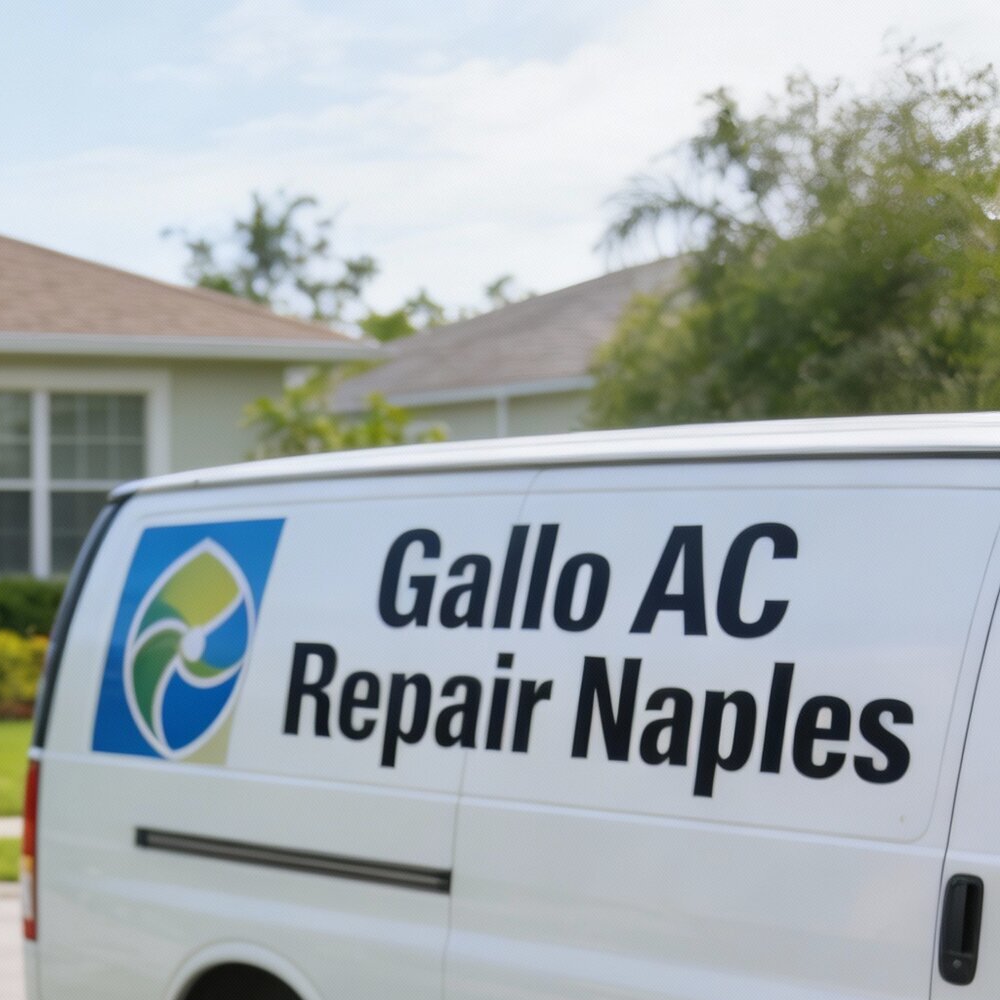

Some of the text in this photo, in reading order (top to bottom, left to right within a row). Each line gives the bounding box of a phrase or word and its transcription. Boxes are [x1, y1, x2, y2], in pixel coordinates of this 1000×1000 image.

[378, 522, 799, 640] Gallo AC
[283, 642, 914, 799] Repair Naples
